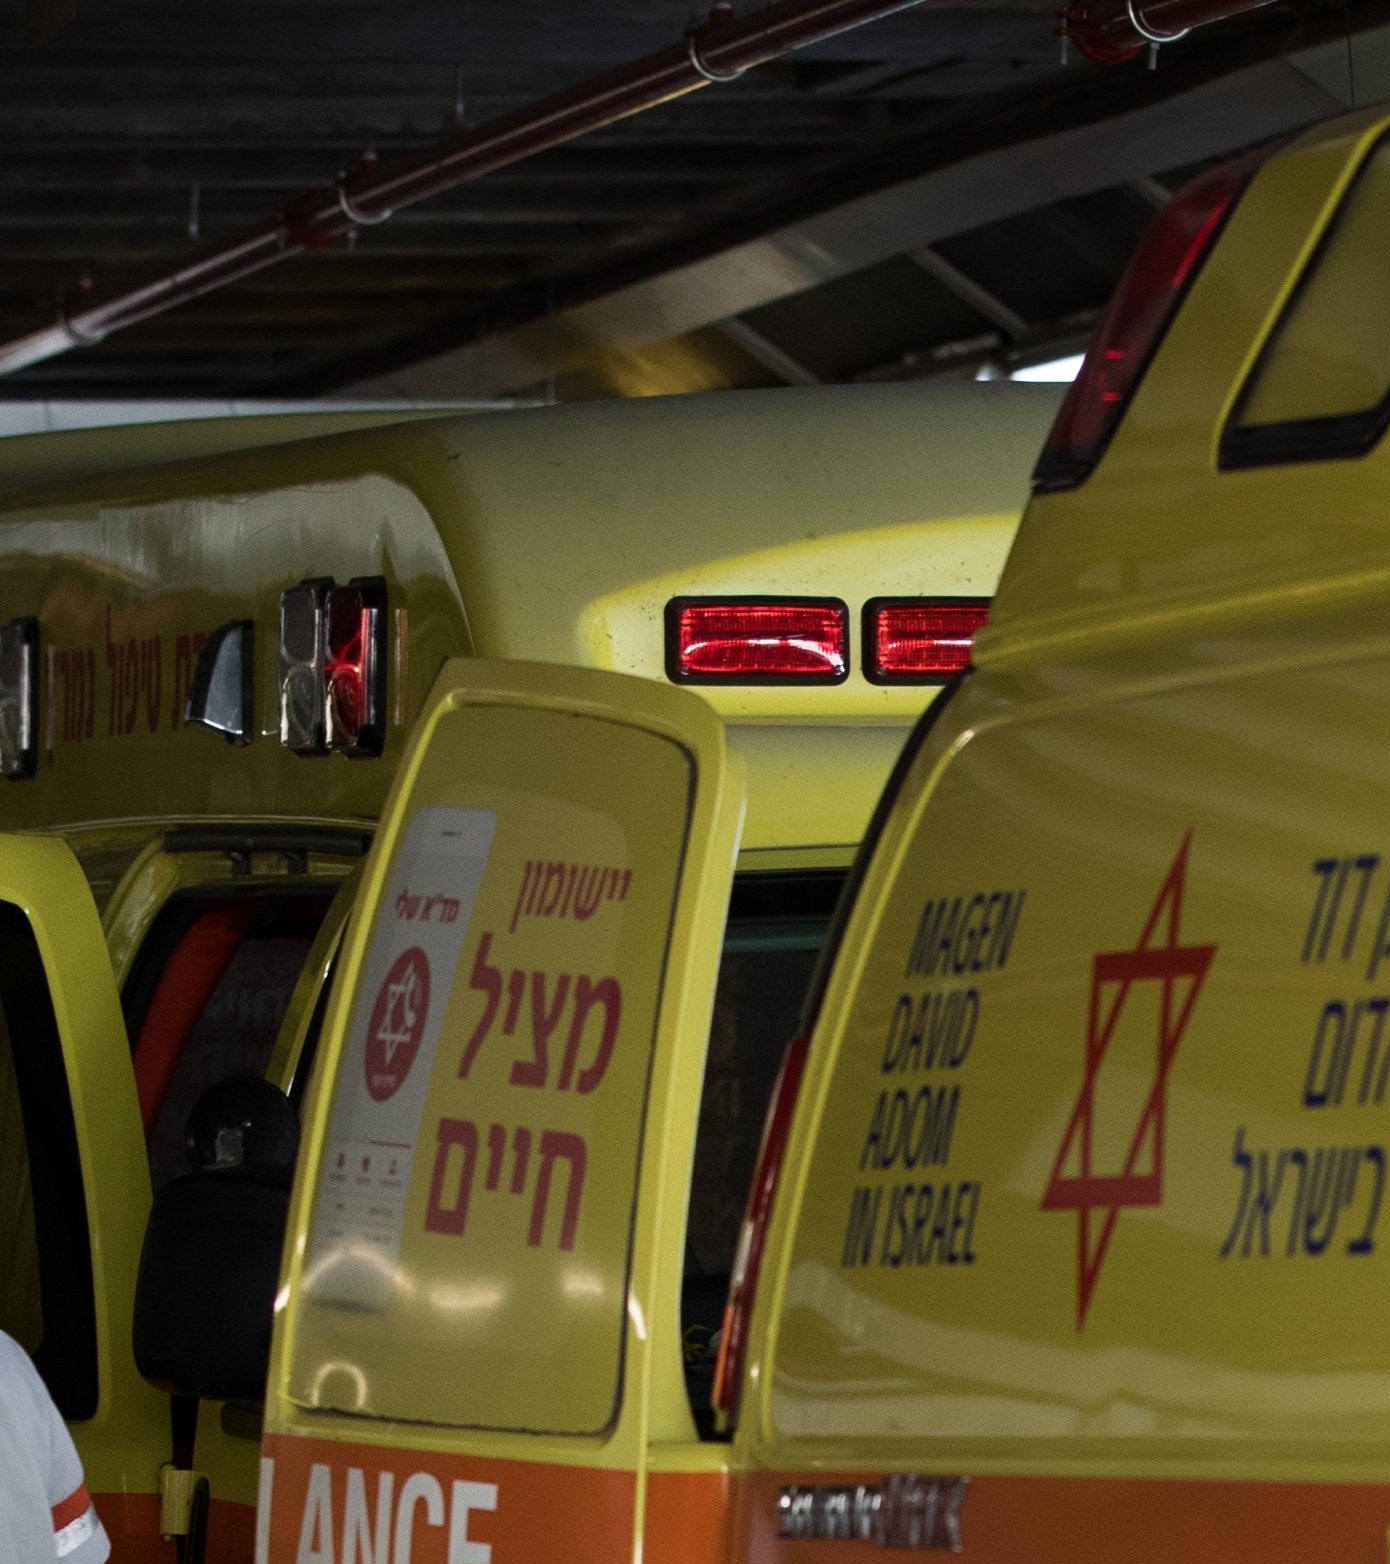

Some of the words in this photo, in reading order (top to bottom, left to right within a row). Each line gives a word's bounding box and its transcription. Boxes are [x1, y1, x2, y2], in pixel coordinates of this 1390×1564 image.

[509, 860, 632, 935] יישומון
[905, 890, 1026, 977] MAGEN
[1300, 853, 1381, 964] דוד
[456, 931, 622, 1095] מציל
[881, 988, 979, 1073] DAVID
[859, 1085, 961, 1170] ADOM
[423, 1115, 588, 1252] חיים
[842, 1183, 884, 1268] IN
[880, 1180, 981, 1267] ISRAEL
[1220, 1126, 1386, 1262] בישראל
